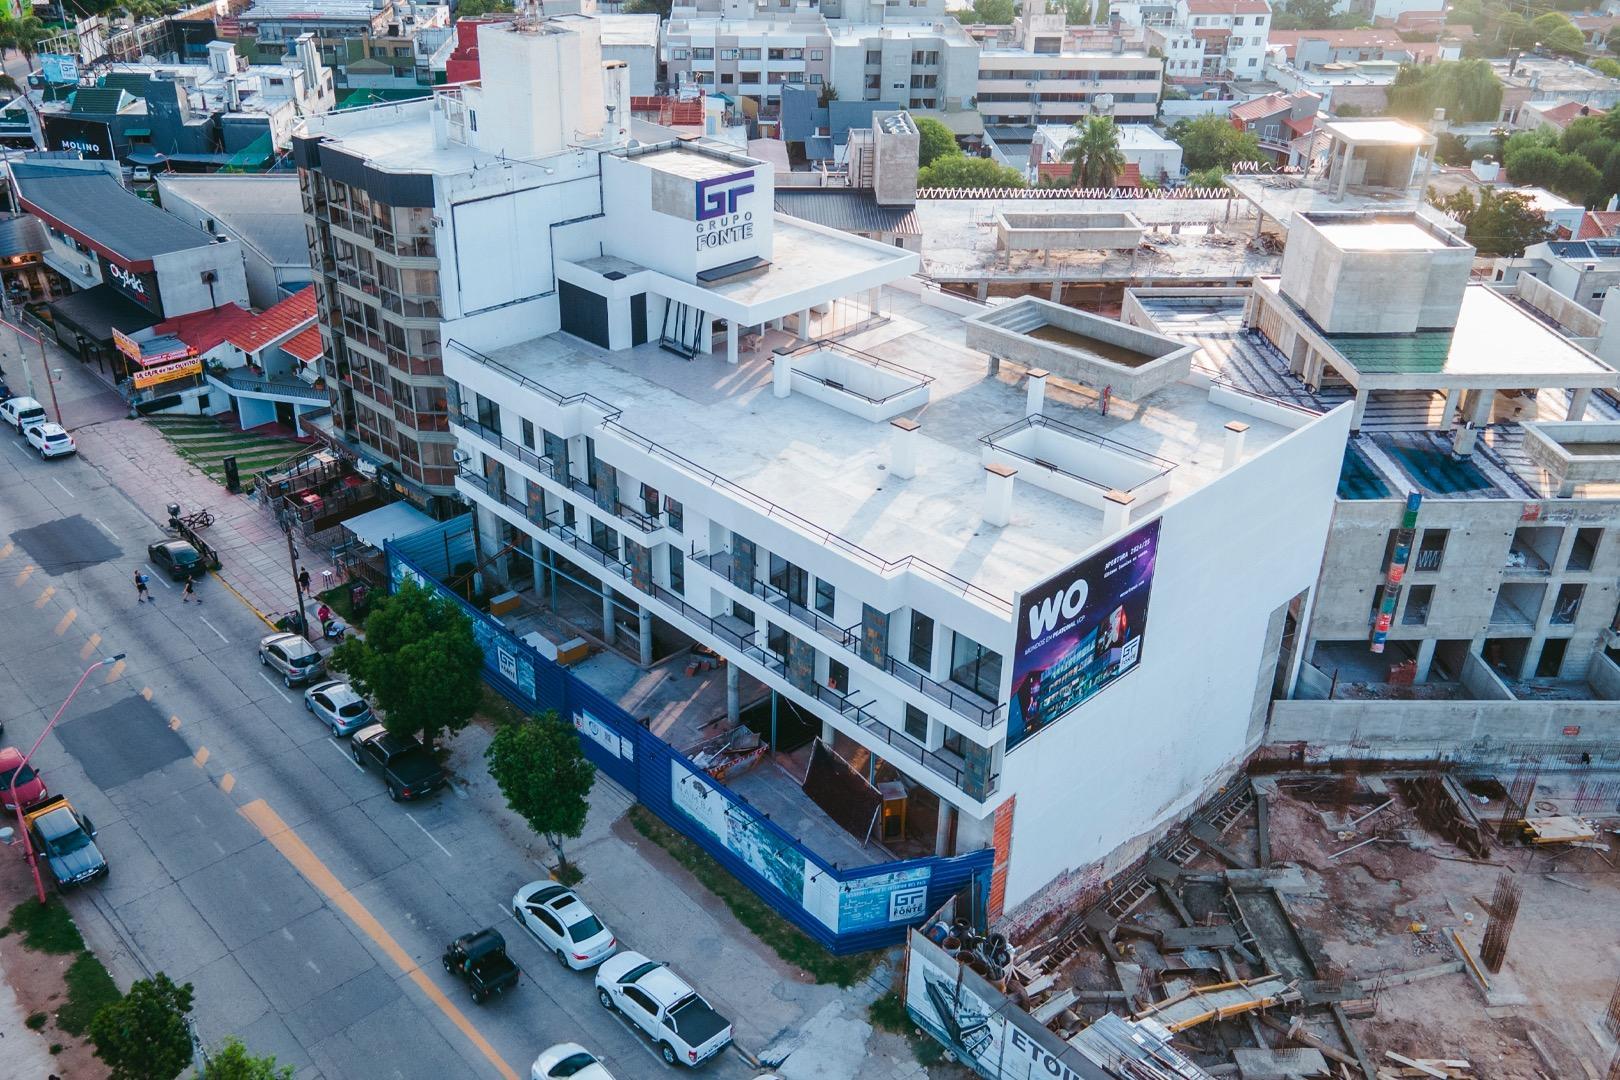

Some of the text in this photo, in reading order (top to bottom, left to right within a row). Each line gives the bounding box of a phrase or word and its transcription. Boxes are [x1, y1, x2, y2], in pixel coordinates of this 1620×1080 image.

[61, 139, 100, 152] MOLINO
[696, 211, 752, 233] GRUPO
[696, 222, 754, 252] FONTE
[1029, 578, 1089, 641] WO
[894, 906, 923, 916] FONTE
